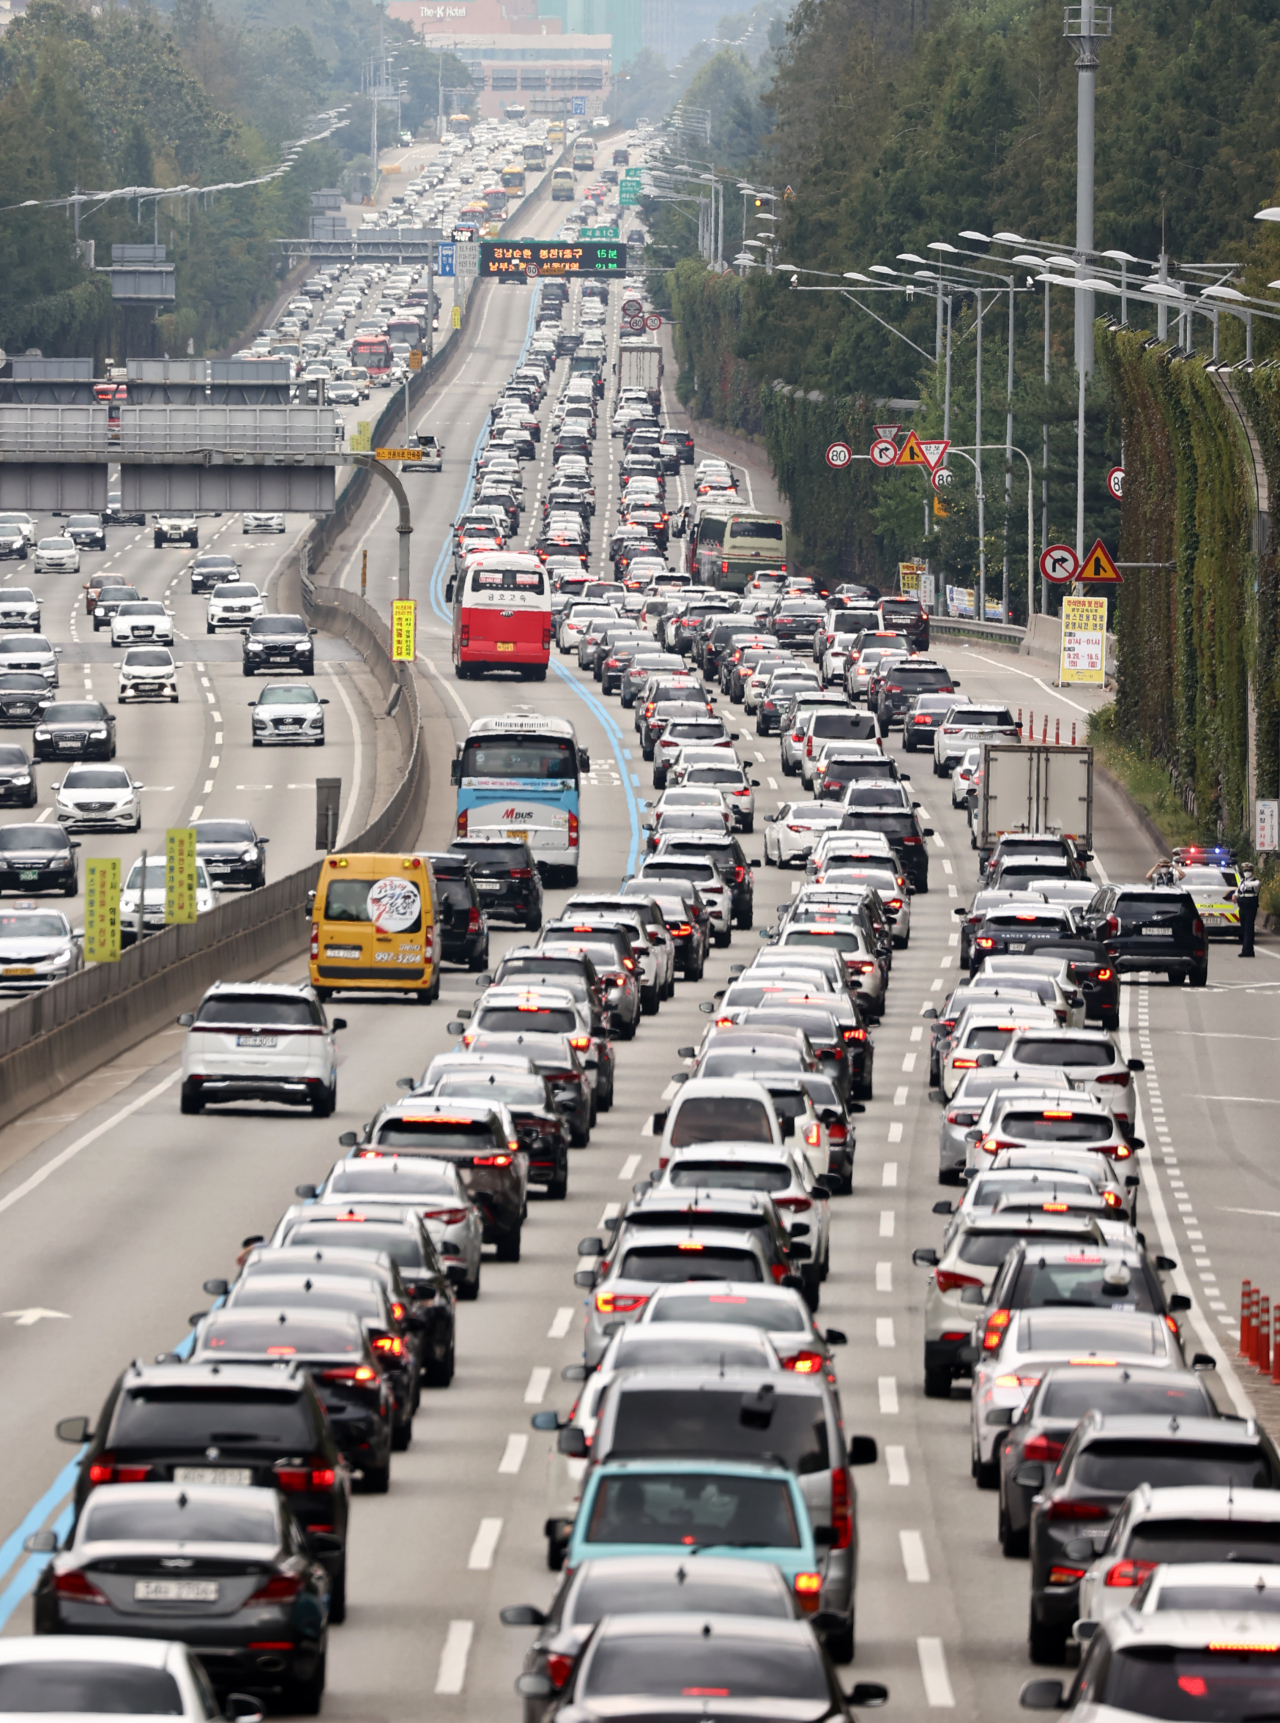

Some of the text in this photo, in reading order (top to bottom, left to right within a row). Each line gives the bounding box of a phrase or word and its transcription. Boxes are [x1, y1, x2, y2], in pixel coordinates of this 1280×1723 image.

[446, 6, 466, 17] Hotel
[527, 266, 537, 275] 80
[631, 319, 643, 328] 80
[831, 449, 846, 462] 80
[937, 474, 953, 486] 80
[1065, 613, 1104, 622] 버스전용차로
[1065, 622, 1104, 631] 운영시간 연장
